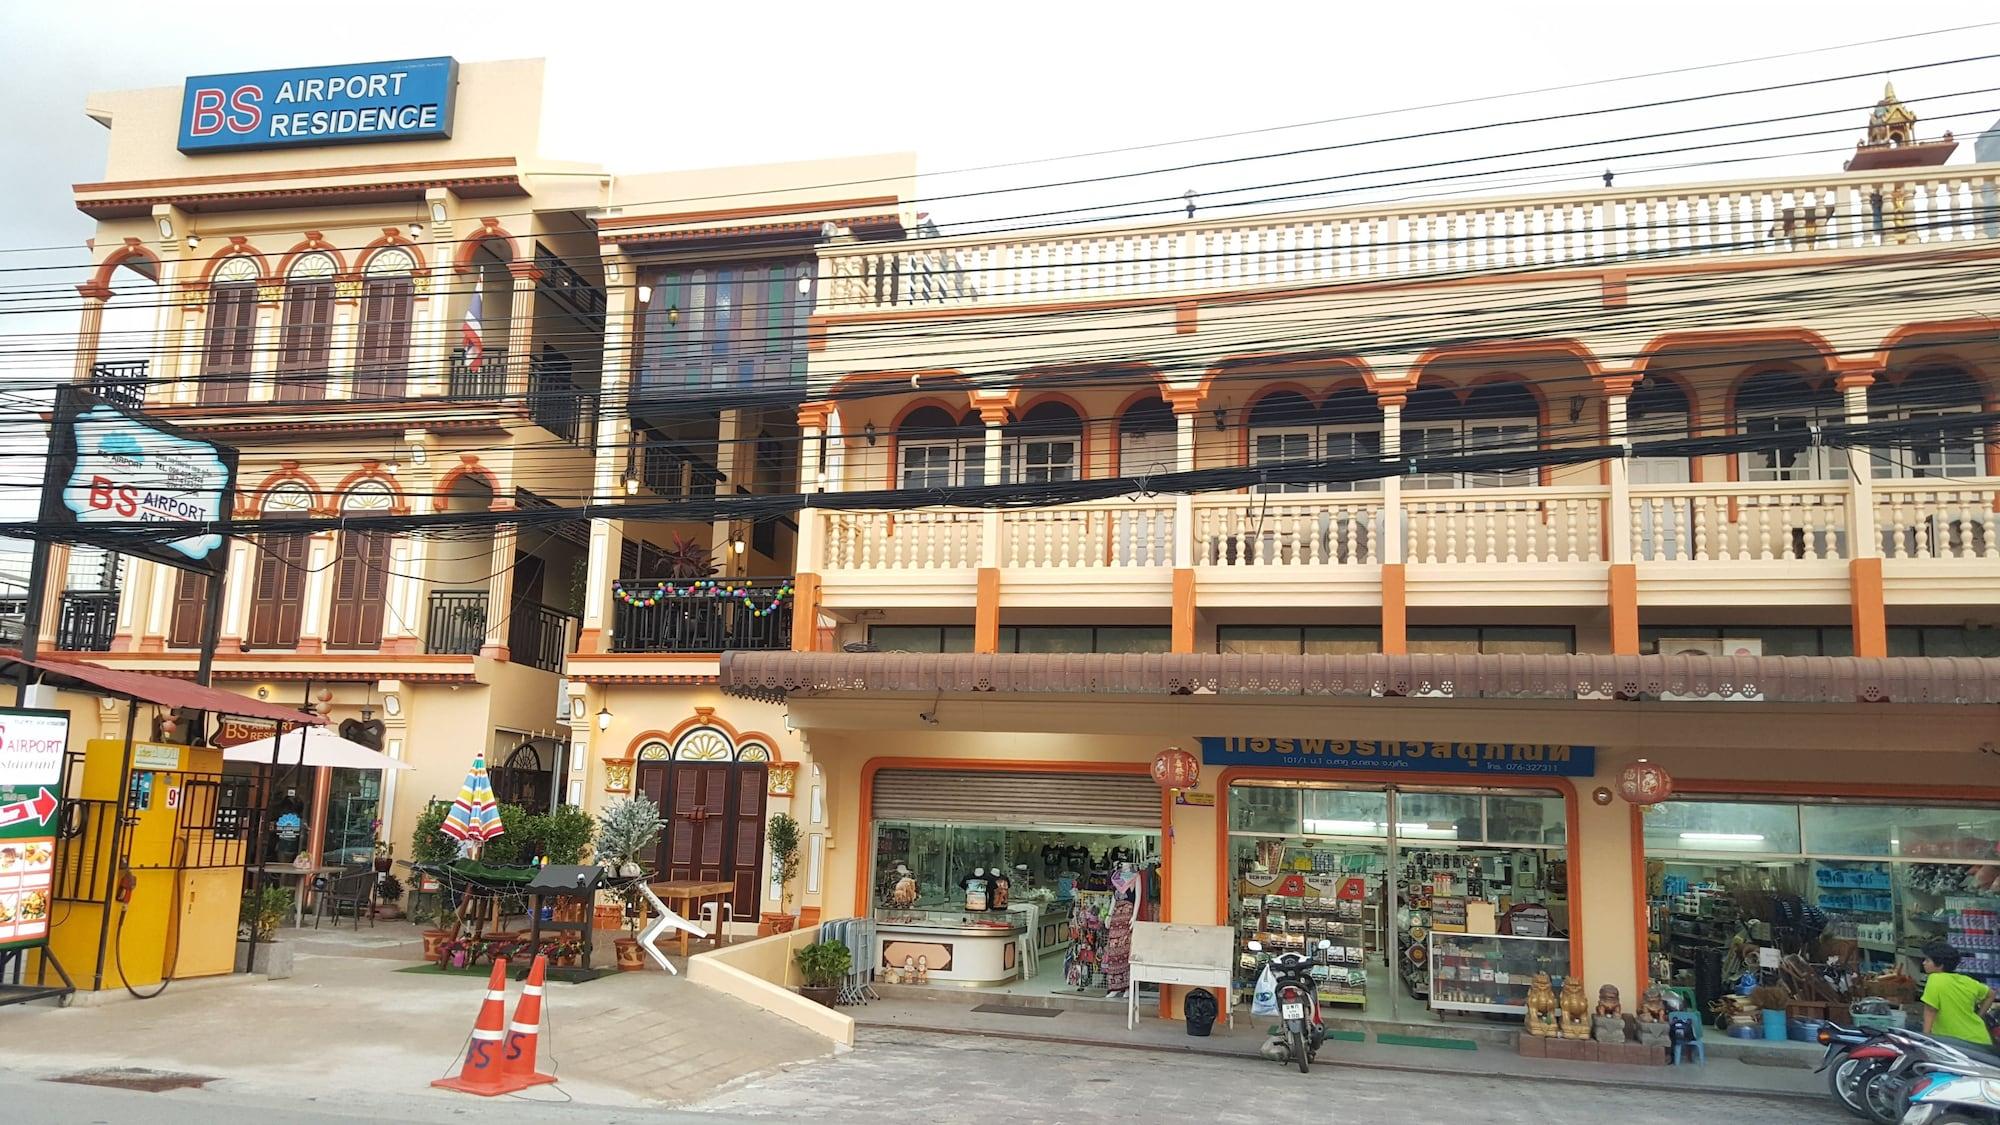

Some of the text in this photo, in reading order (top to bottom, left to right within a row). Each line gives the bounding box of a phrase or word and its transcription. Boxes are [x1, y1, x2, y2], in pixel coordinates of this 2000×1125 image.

[190, 72, 408, 137] BS AIRPORT
[269, 104, 438, 138] RESIDENCE
[89, 475, 138, 518] BS
[143, 492, 206, 522] AIRPORT
[225, 723, 249, 740] BS
[7, 739, 62, 754] AIRPORT
[1506, 762, 1558, 772] 076-327311
